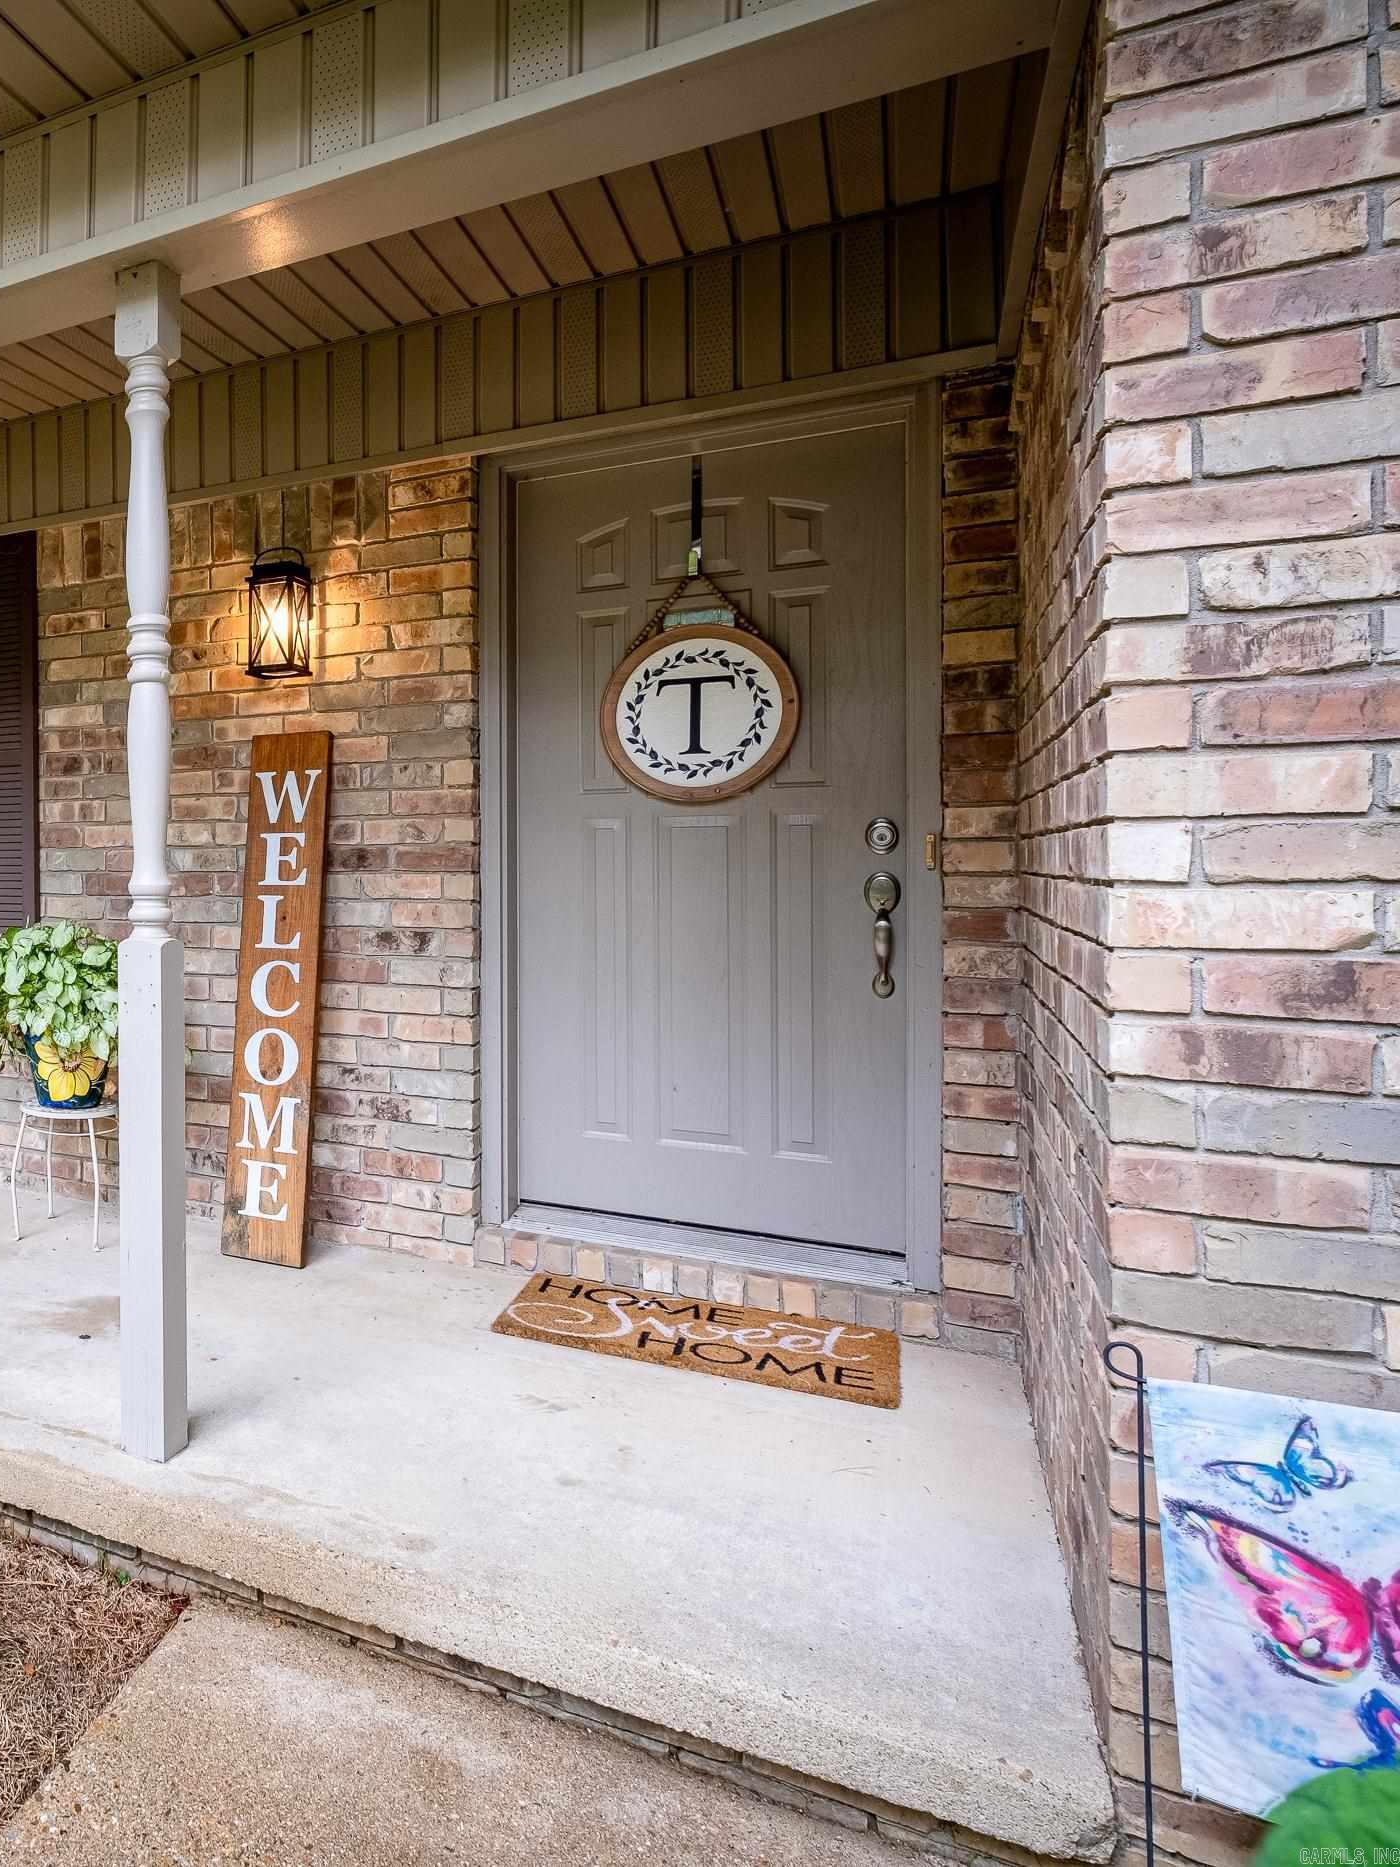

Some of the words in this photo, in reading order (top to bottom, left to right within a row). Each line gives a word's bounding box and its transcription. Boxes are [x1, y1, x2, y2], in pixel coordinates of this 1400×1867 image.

[655, 674, 736, 755] T
[234, 768, 322, 1222] WELCOME
[507, 1298, 876, 1362] Sweet
[538, 1277, 745, 1327] HOME
[637, 1330, 875, 1391] HOME
